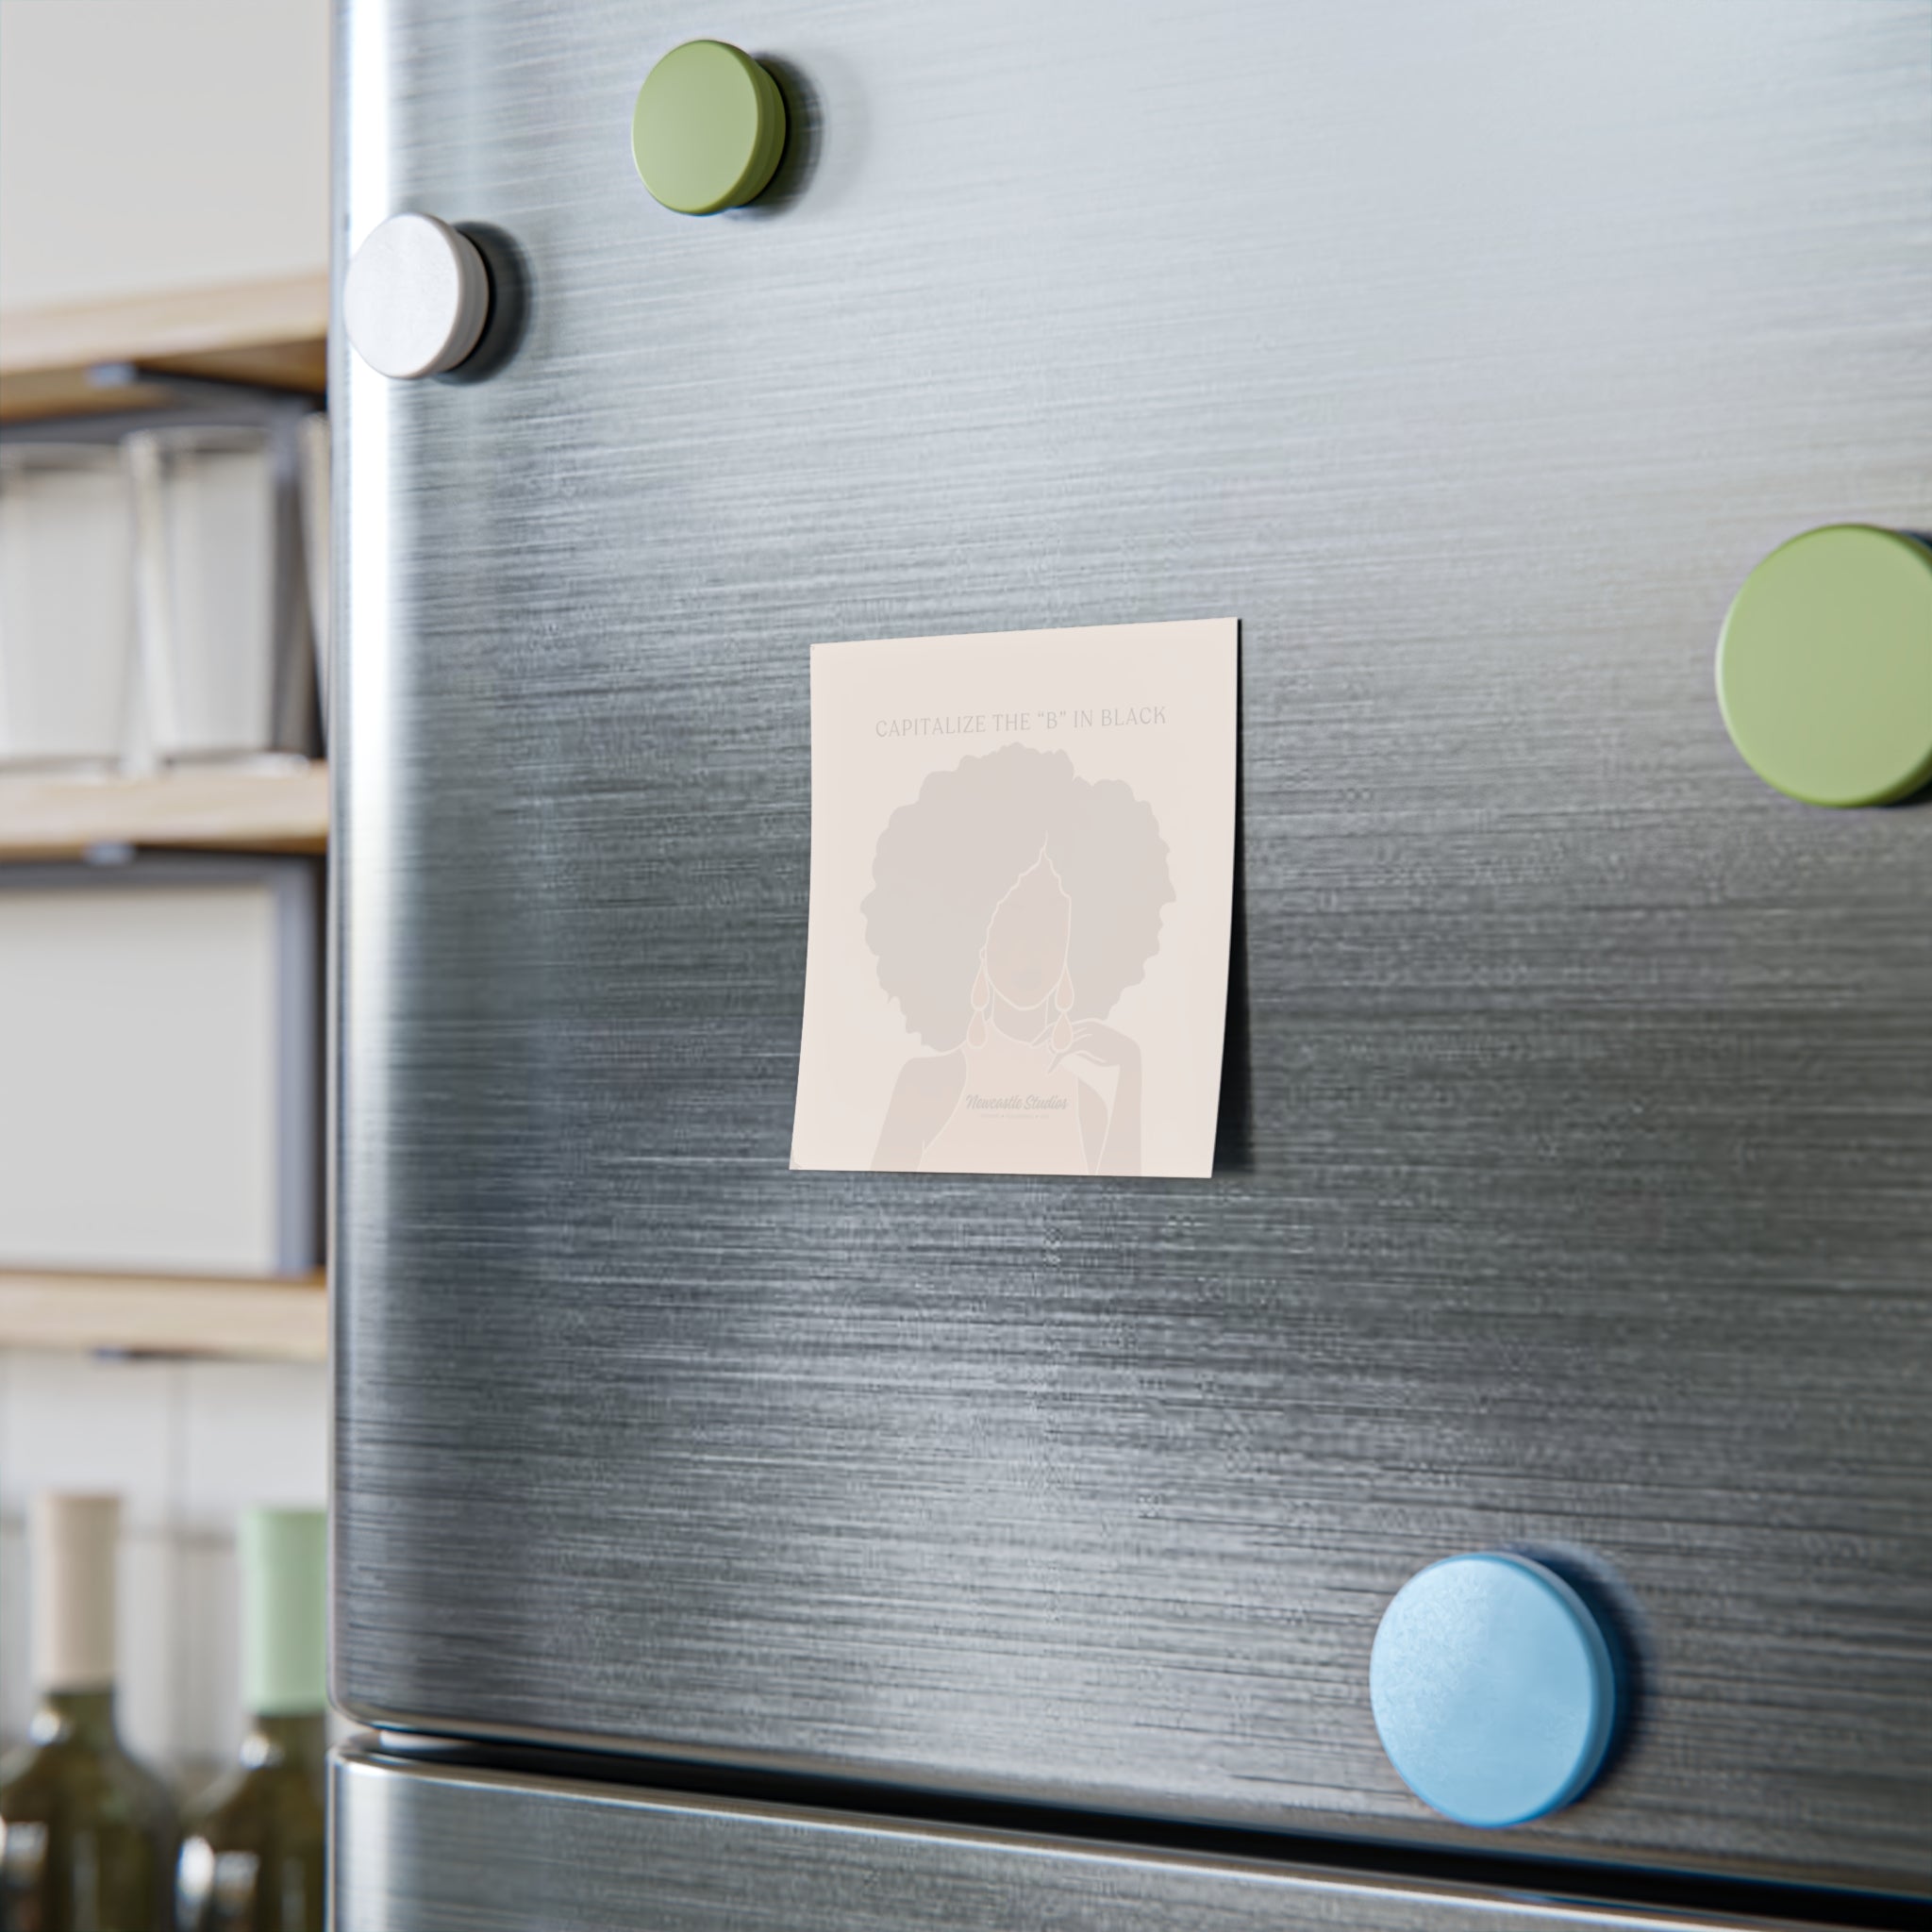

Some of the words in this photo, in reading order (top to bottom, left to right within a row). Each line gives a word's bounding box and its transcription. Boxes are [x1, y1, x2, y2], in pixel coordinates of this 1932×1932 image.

[875, 714, 987, 738] CAPITALIZE
[991, 712, 1031, 732] THE
[1073, 708, 1093, 728] IN
[1100, 706, 1167, 727] BLACK
[965, 1094, 1023, 1111] Newcastle
[1023, 1094, 1068, 1111] Studios
